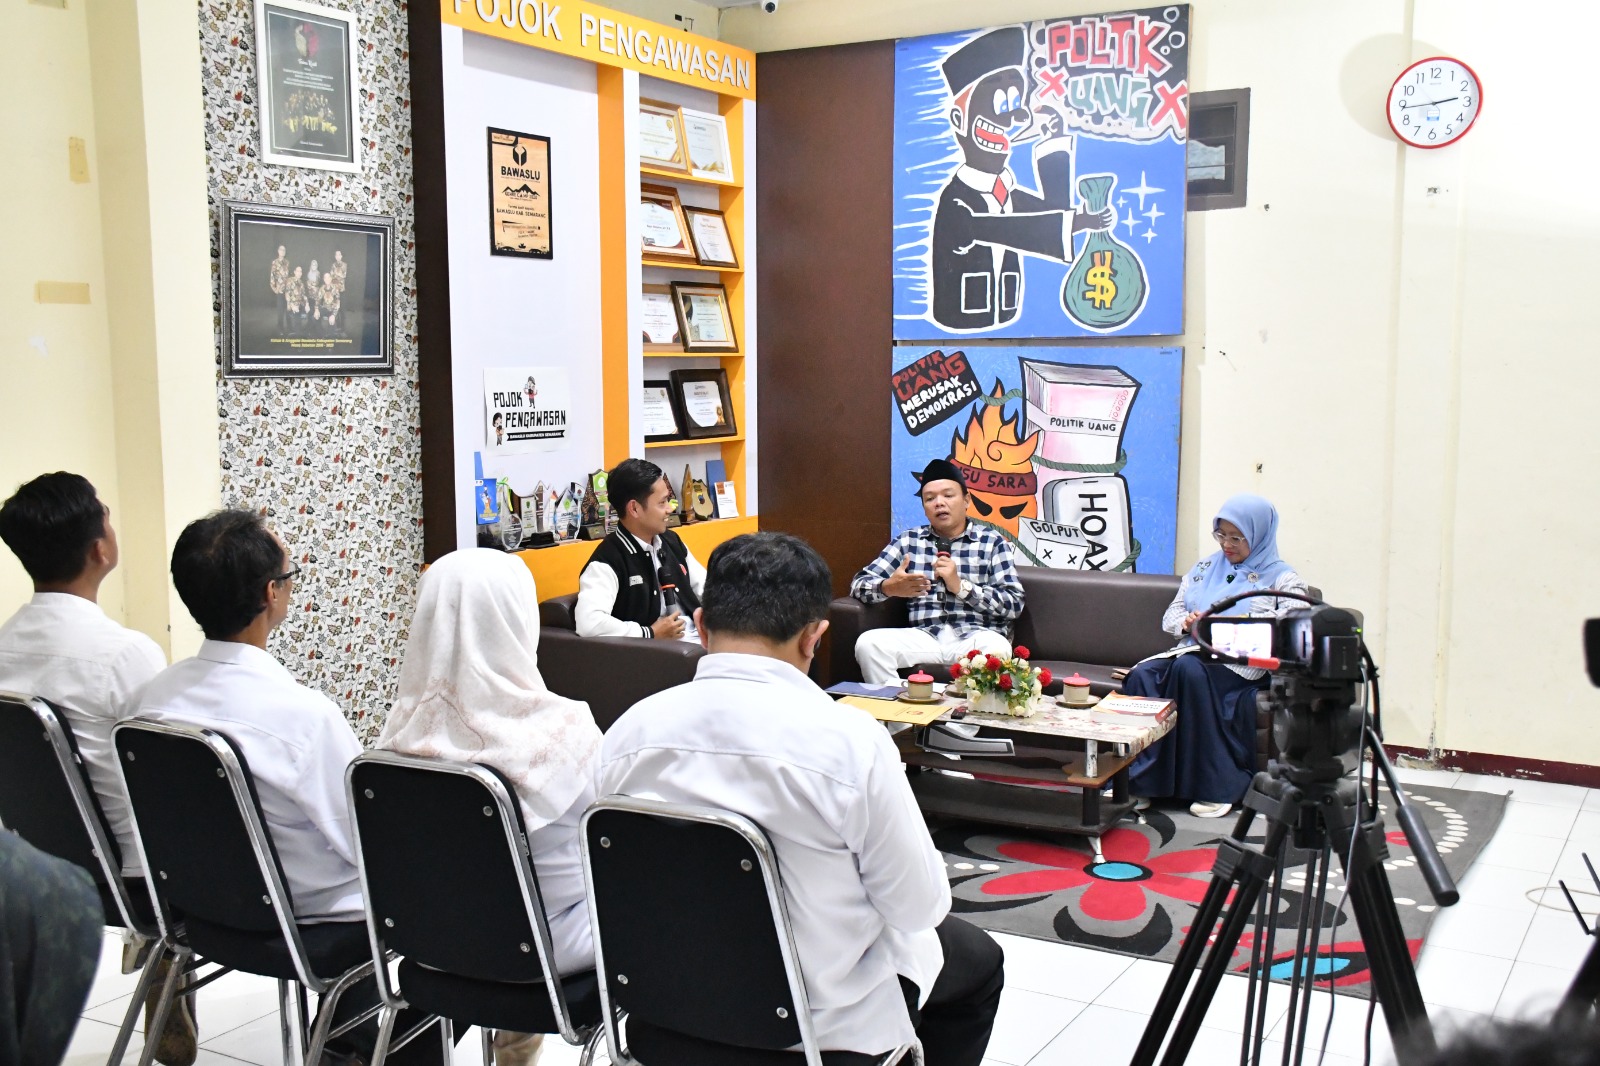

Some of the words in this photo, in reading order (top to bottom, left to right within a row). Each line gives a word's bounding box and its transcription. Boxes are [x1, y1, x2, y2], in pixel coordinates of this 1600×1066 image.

[580, 12, 750, 90] PENGAWASAN
[1047, 15, 1171, 76] POLITIK
[1416, 72, 1425, 84] 11
[1430, 67, 1442, 79] 12
[1451, 70, 1455, 82] 1
[1403, 85, 1415, 96] 10
[1460, 80, 1469, 92] 2
[1069, 73, 1152, 129] UANG
[1398, 99, 1407, 111] 9
[1462, 96, 1472, 107] 3
[1402, 114, 1411, 125] 8
[1456, 112, 1464, 123] 4
[1413, 125, 1421, 136] 7
[1428, 128, 1437, 140] 6
[1445, 124, 1453, 135] 5
[501, 165, 540, 181] BAWASLU
[892, 351, 943, 388] POLITIK
[897, 353, 966, 401] UANG
[493, 391, 523, 408] POJOK
[901, 376, 962, 414] MERUSAK
[907, 380, 977, 428] DEMOKRASI
[505, 410, 566, 429] PENGAWASAN
[1050, 417, 1084, 428] POLITIK
[1088, 422, 1116, 432] UANG
[987, 474, 1027, 489] SARA
[1030, 521, 1080, 538] GOLPUT
